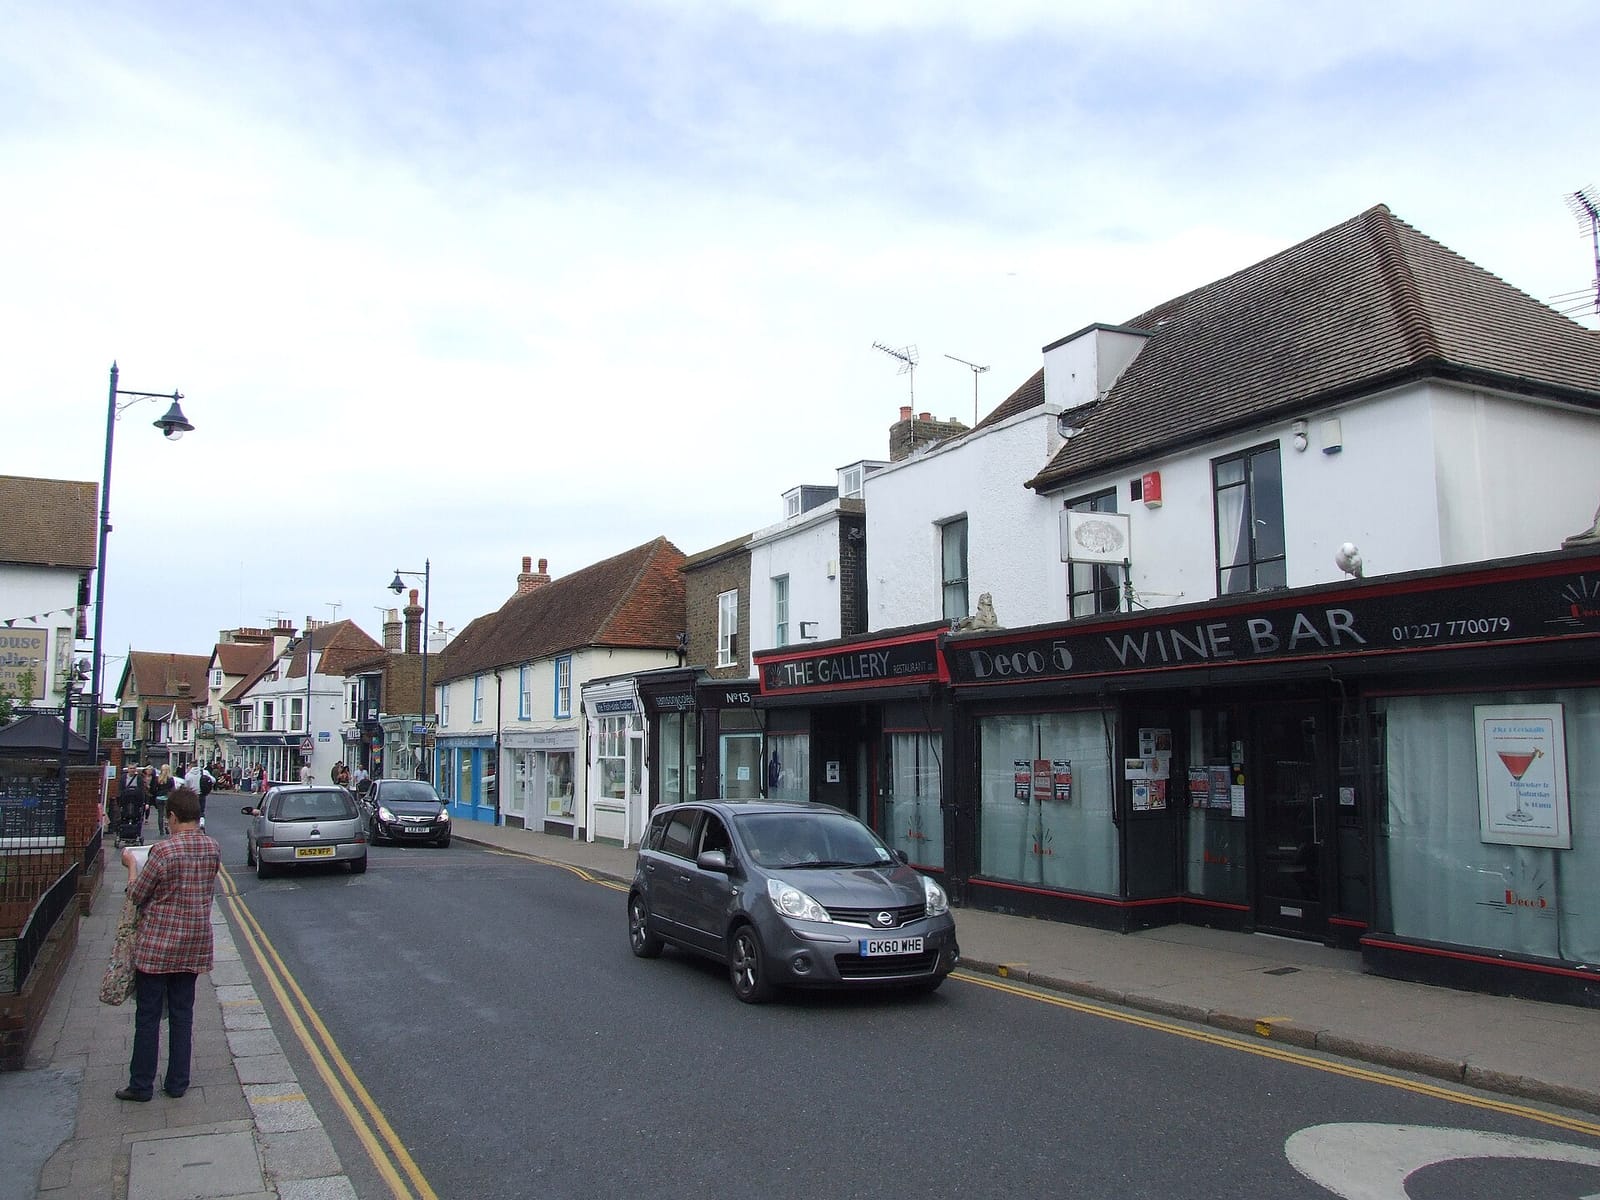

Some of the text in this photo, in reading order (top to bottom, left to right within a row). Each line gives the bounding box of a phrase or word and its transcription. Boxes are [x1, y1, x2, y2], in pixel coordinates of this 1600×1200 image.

[1105, 608, 1367, 666] WINE BAR
[1392, 616, 1510, 640] 01227 770079
[784, 661, 814, 686] THE
[818, 651, 890, 683] GALLERY
[970, 640, 1073, 678] Deco 5
[869, 939, 921, 954] GK60 WHE
